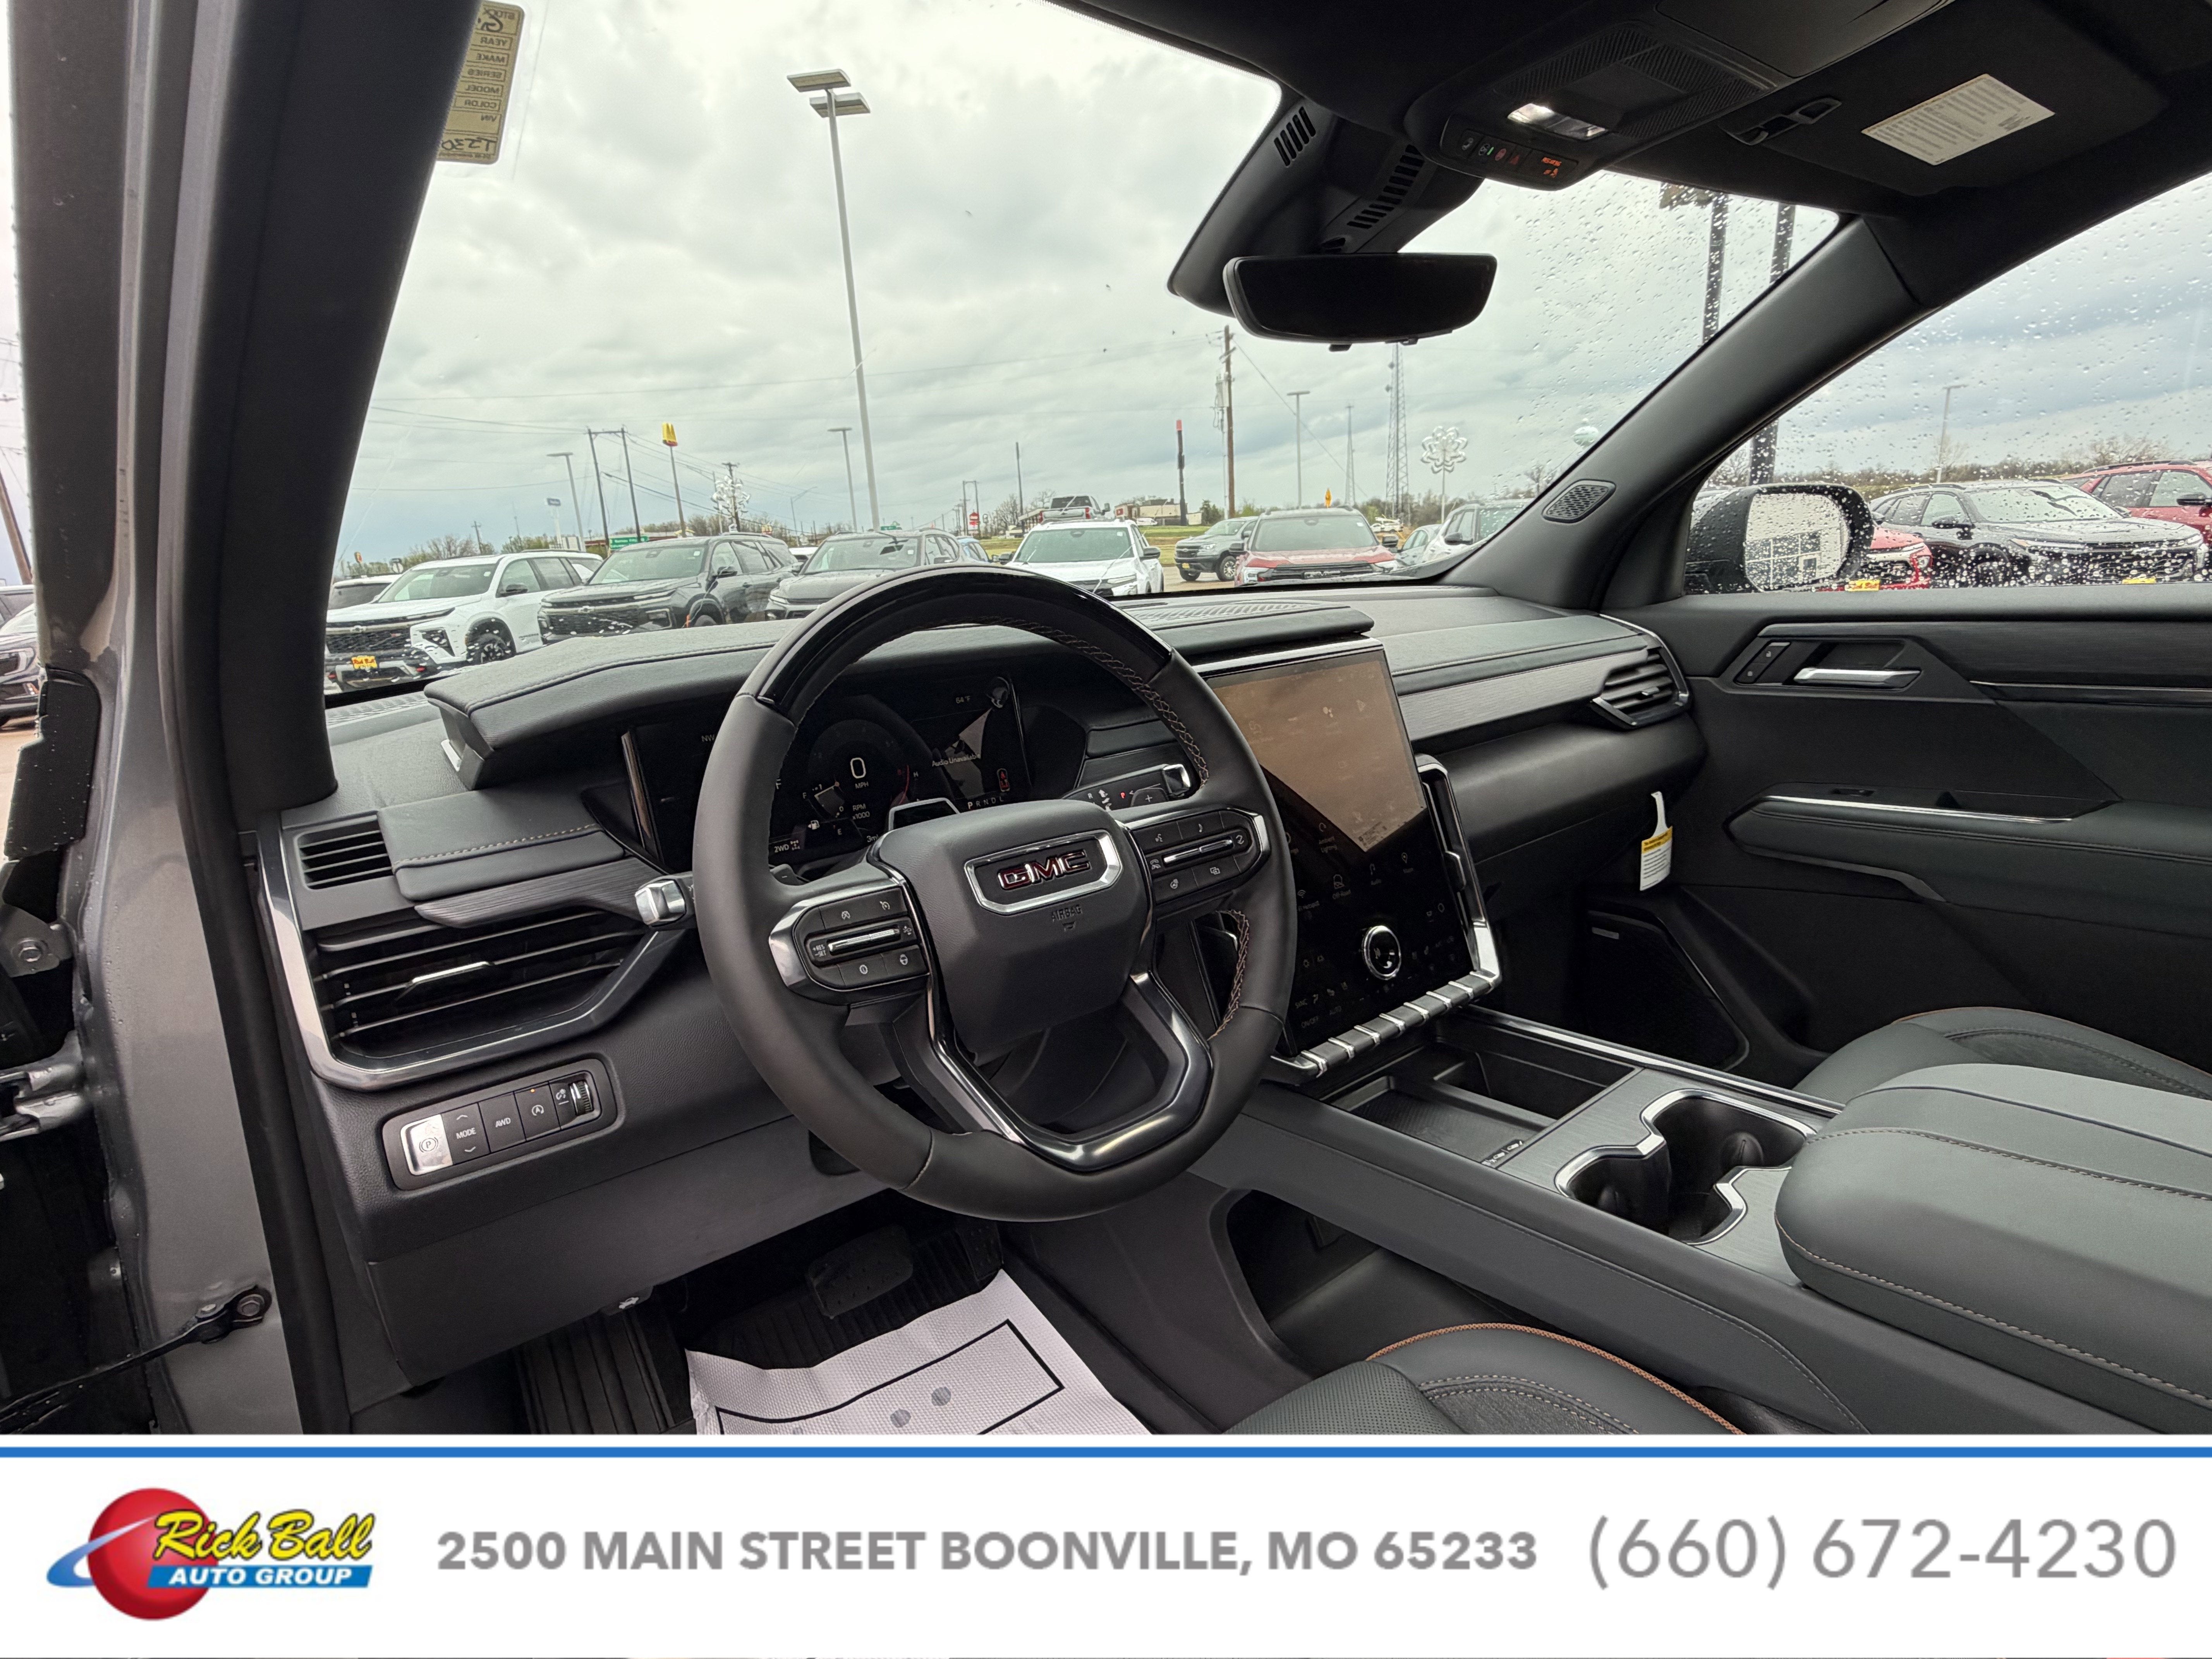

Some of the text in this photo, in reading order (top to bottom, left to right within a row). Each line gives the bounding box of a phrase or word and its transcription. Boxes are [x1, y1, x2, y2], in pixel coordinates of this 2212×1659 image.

[850, 757, 866, 779] 0
[853, 803, 866, 811] RPM
[852, 811, 870, 820] x1000
[774, 844, 789, 852] 2WD
[998, 850, 1092, 890] GMC
[1052, 904, 1083, 922] AIRBAG
[495, 1118, 511, 1128] AWD
[456, 1127, 477, 1139] MODE
